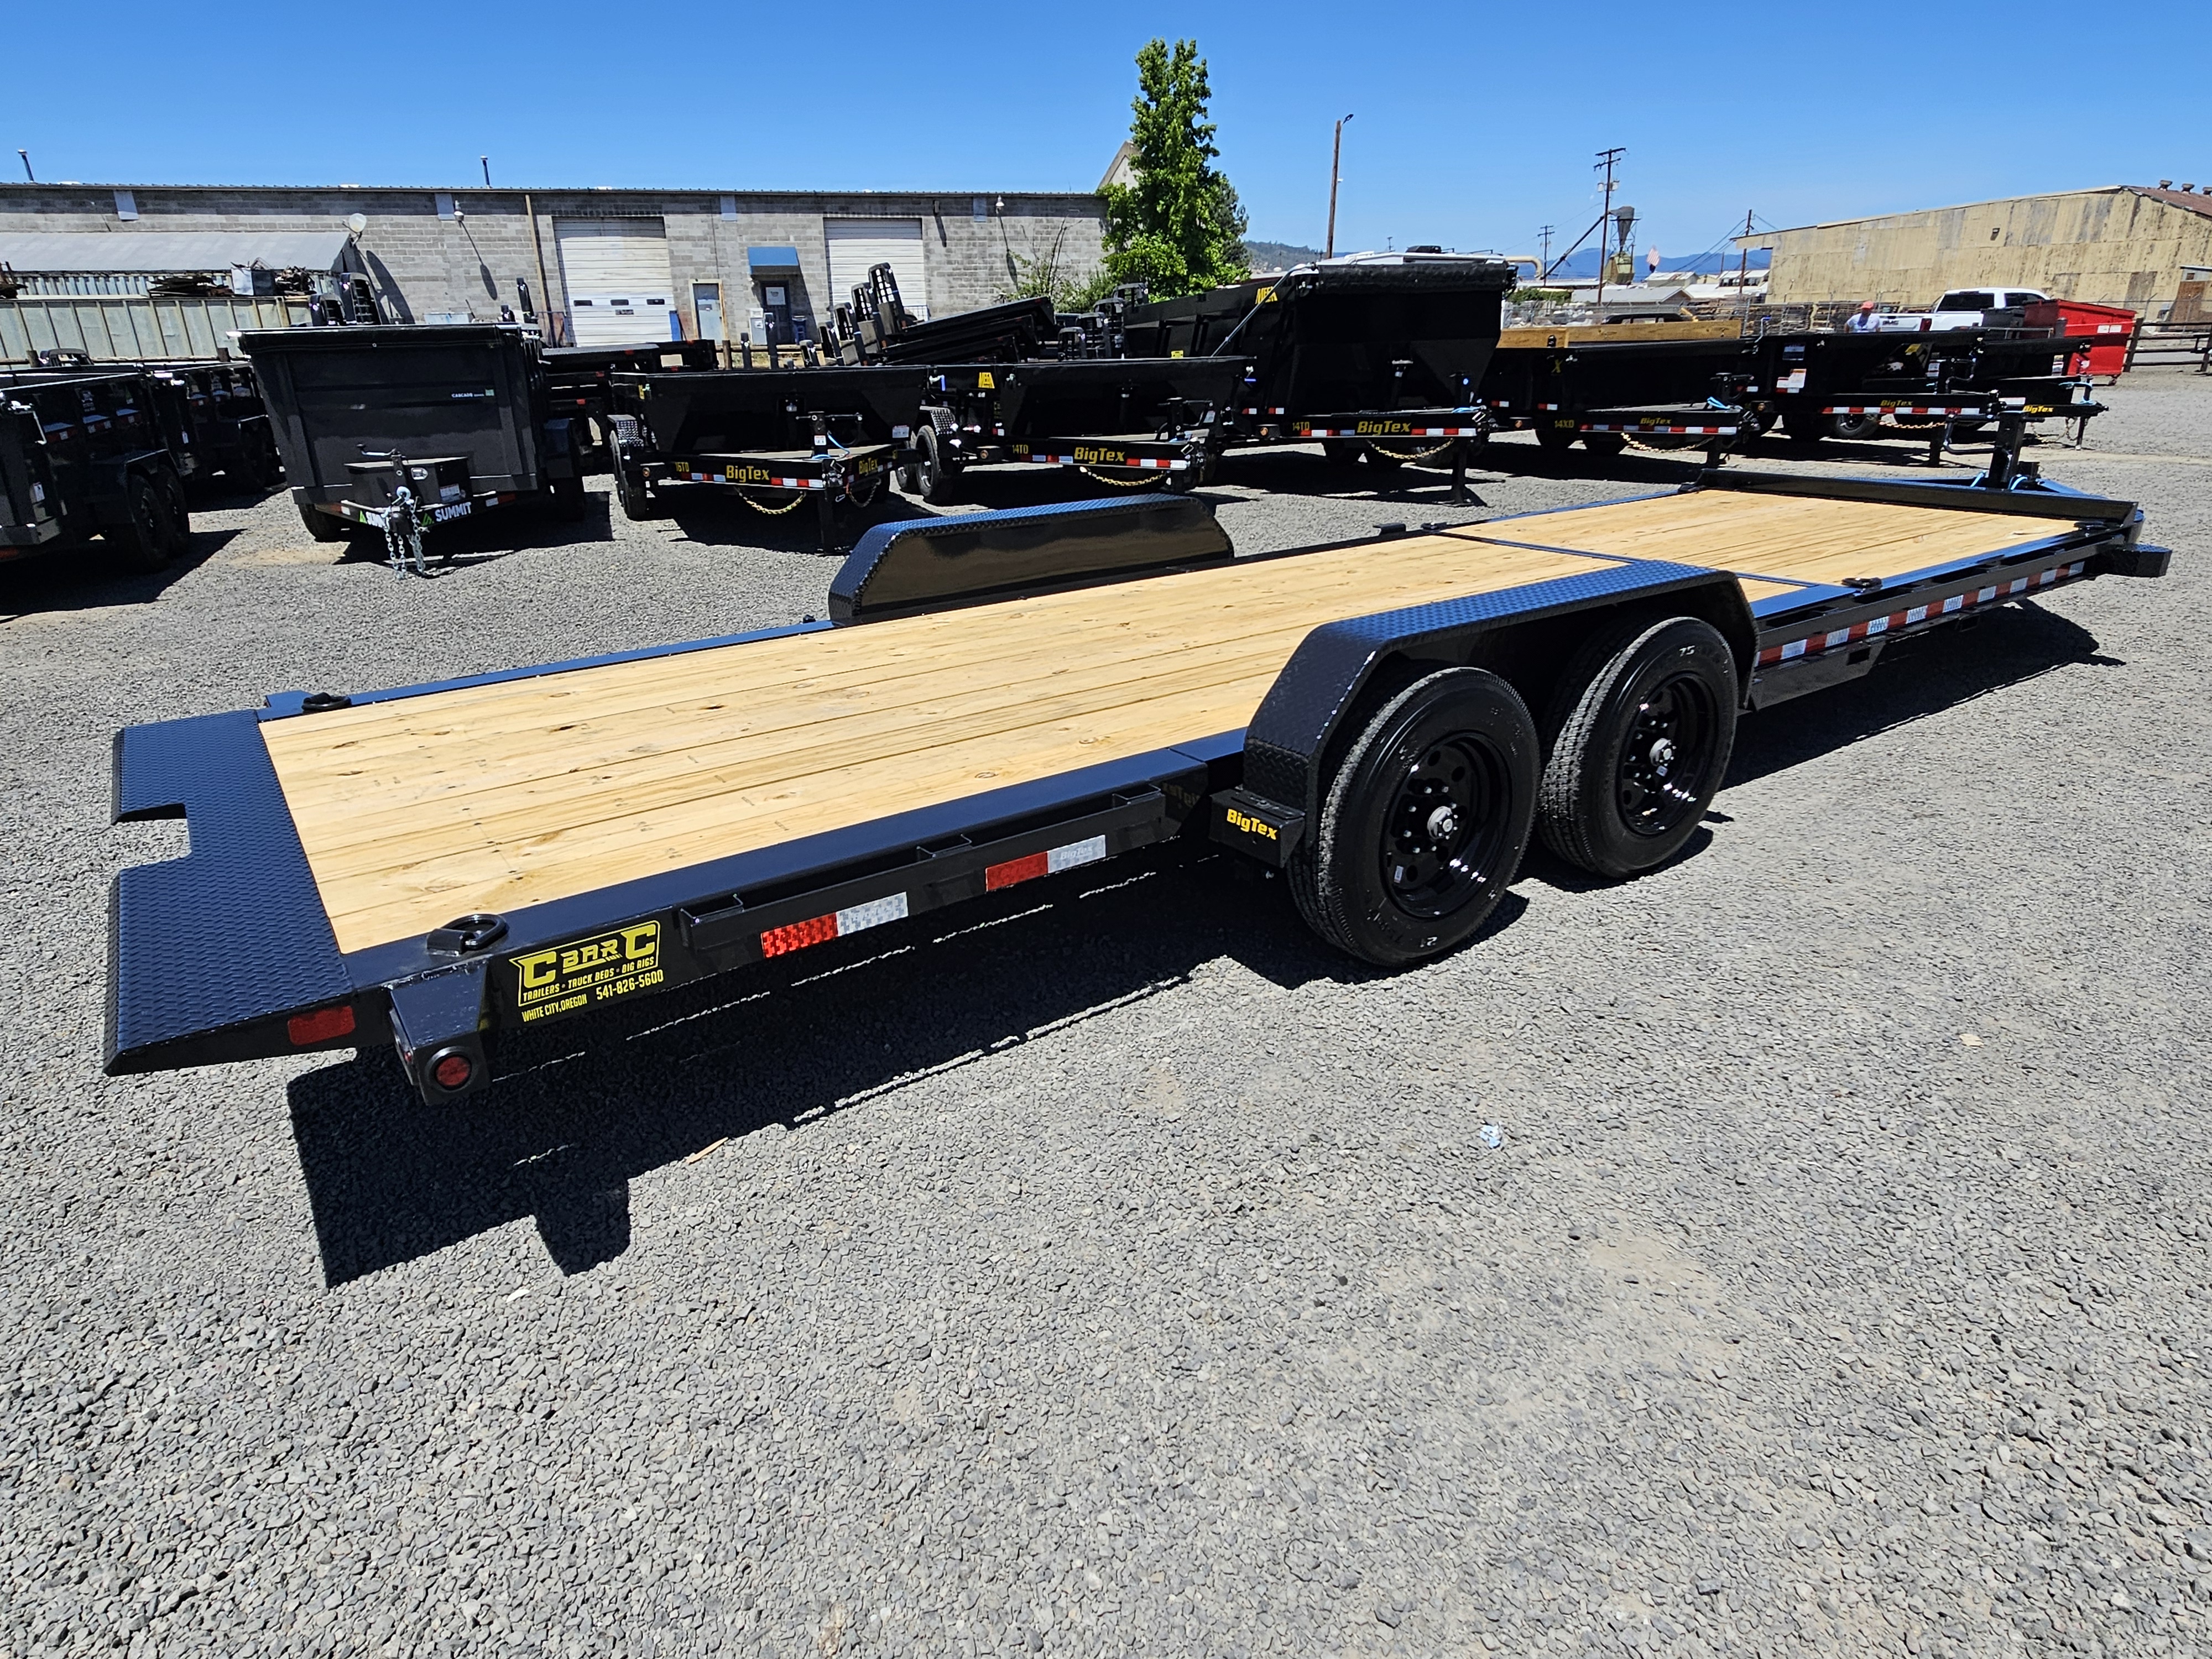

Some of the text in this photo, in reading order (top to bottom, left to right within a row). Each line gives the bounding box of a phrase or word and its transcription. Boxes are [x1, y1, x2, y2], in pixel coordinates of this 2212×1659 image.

[2022, 405, 2054, 414] BigTex
[1357, 420, 1411, 436] BigTex
[1639, 417, 1672, 426] BigTex
[1074, 447, 1125, 465] BigTex
[726, 465, 770, 483] BigTex
[435, 502, 472, 522] SUMMIT
[1227, 808, 1278, 840] BigTex
[518, 924, 656, 988] C BAR C
[523, 956, 655, 1002] TRAILERS TRUCK BEDS BIG RIGS
[521, 1008, 544, 1022] WHITE
[596, 969, 664, 1000] 541-826-5600
